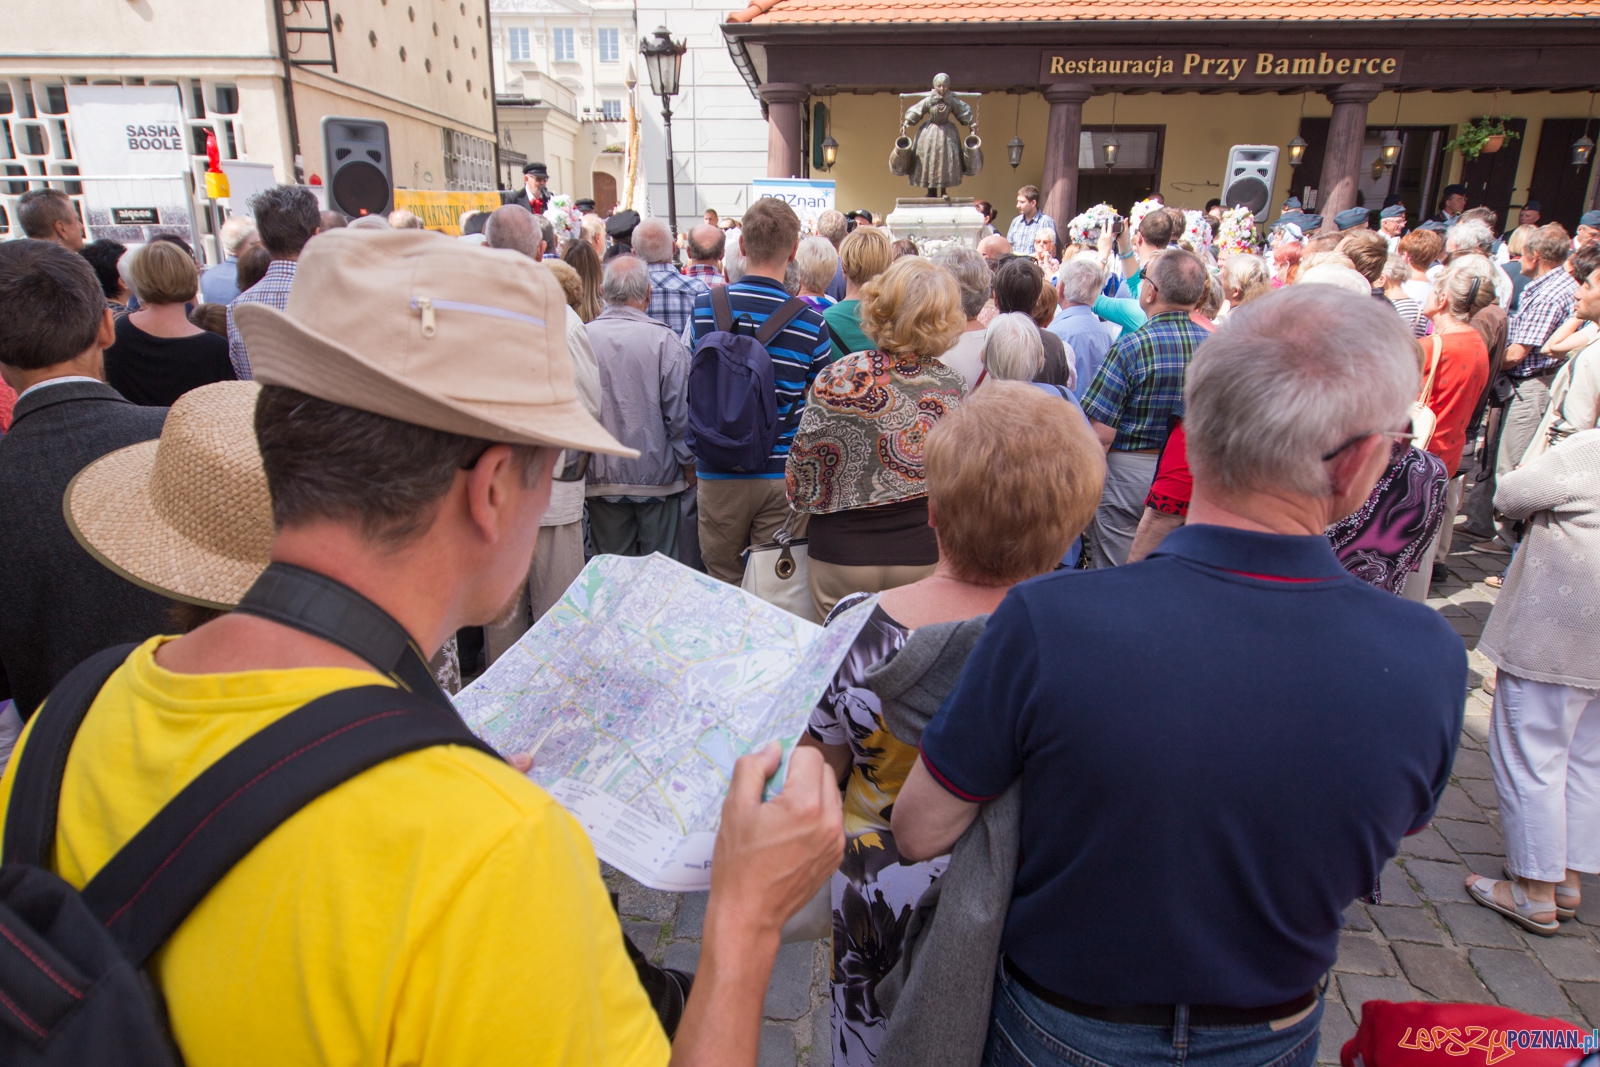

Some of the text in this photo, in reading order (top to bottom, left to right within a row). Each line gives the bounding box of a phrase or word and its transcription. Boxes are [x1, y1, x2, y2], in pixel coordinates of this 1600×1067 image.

[1050, 52, 1397, 81] Restauracja Przy Bamberce
[126, 125, 180, 137] SASHA
[129, 138, 183, 150] BOOLE
